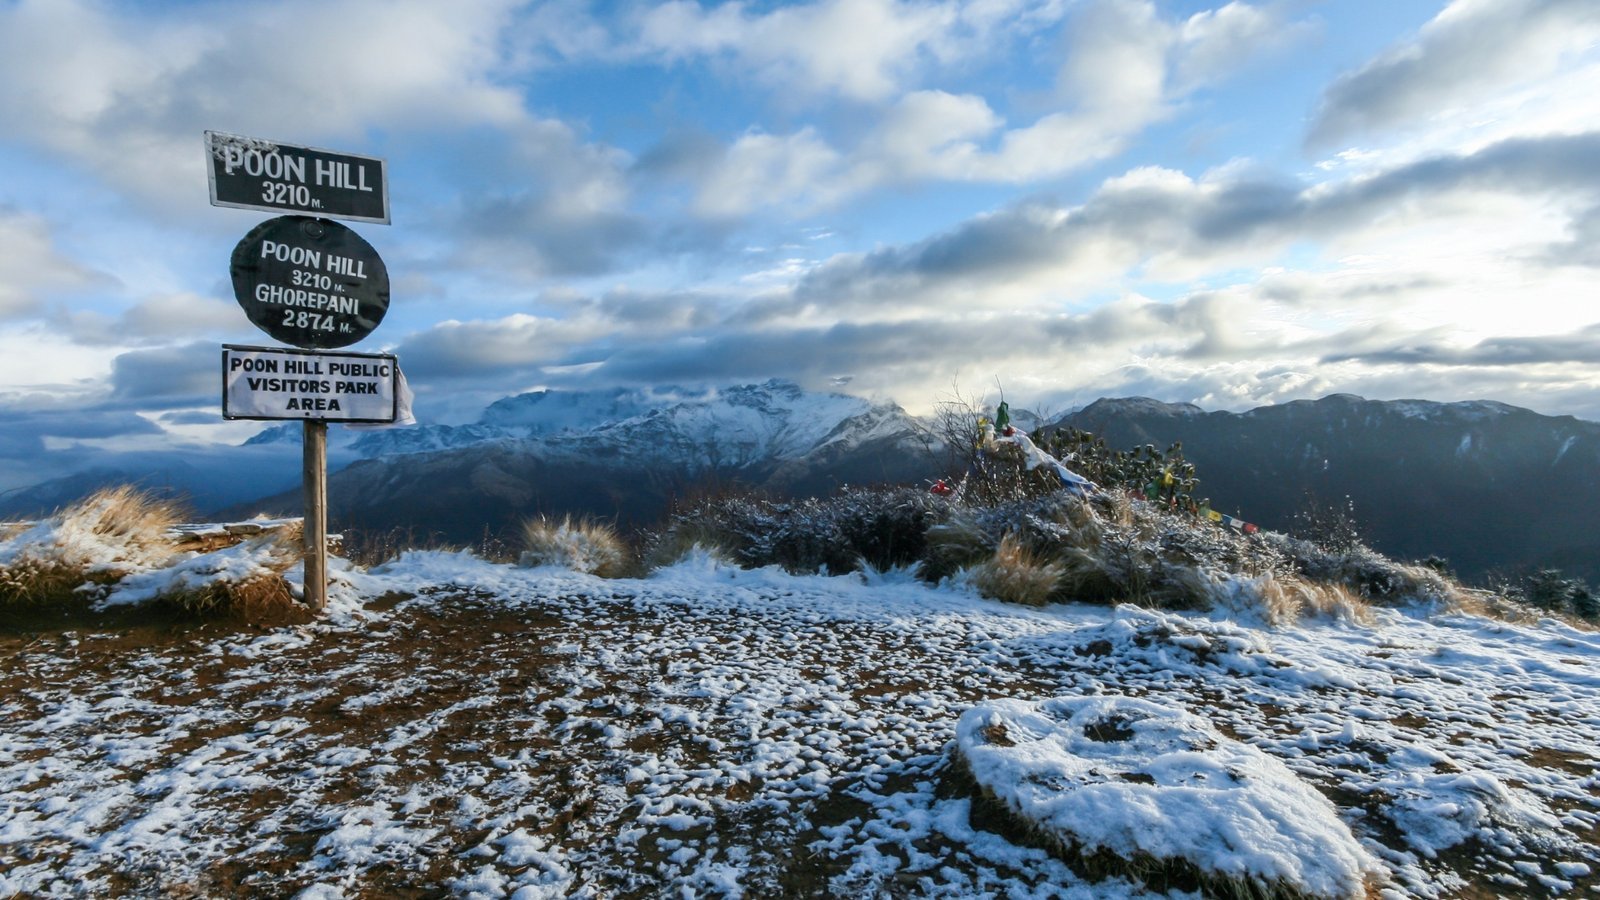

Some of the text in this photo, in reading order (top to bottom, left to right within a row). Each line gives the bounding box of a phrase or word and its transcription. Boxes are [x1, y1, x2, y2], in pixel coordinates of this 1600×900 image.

[225, 146, 373, 192] POON HILL
[262, 181, 310, 207] 3210
[261, 240, 367, 279] POON HILL
[292, 270, 331, 291] 3210
[255, 283, 359, 315] GHOREPANI
[282, 309, 335, 332] 2874
[230, 358, 389, 377] POON HILL PUBLIC
[247, 377, 378, 394] VISITORS PARK
[286, 398, 341, 411] AREA
